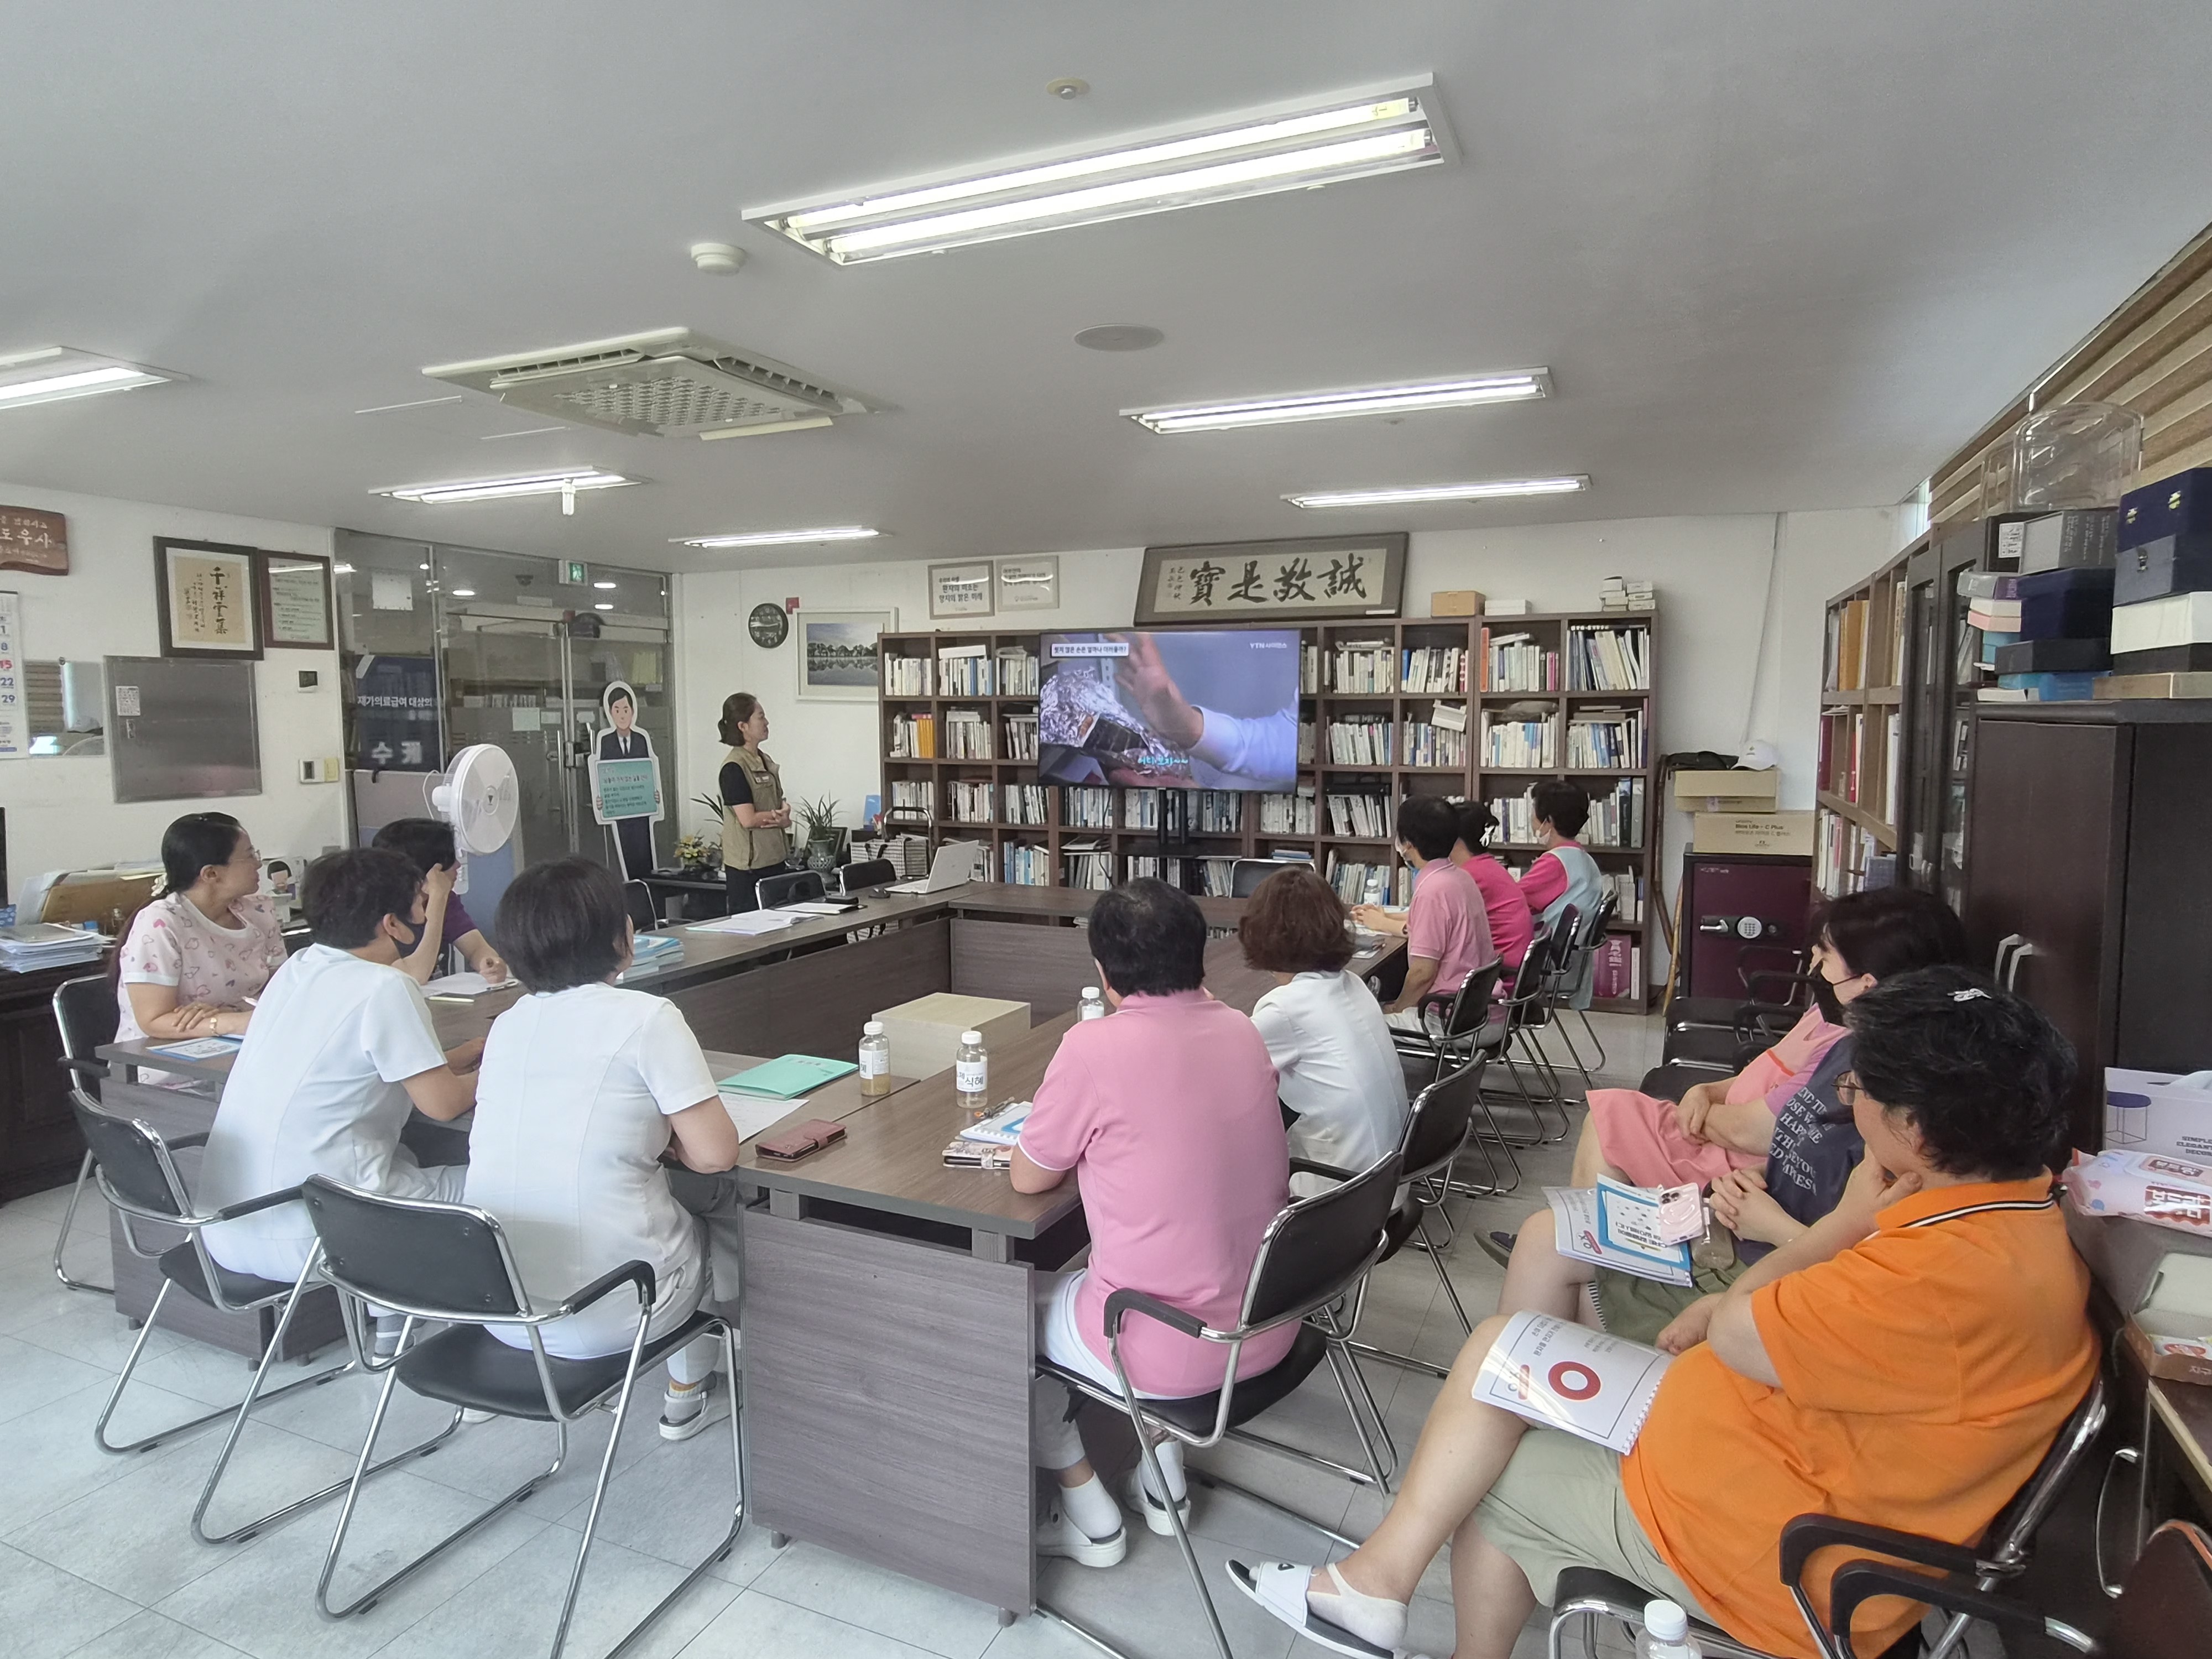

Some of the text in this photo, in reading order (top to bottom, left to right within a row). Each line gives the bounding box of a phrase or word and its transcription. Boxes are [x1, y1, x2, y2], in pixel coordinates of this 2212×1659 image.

[971, 592, 983, 601] 미래
[1, 642, 8, 651] 8
[0, 677, 14, 687] 22
[2, 695, 15, 704] 29
[357, 696, 432, 708] 재가의료급여 대상의
[964, 1076, 984, 1087] 식혜
